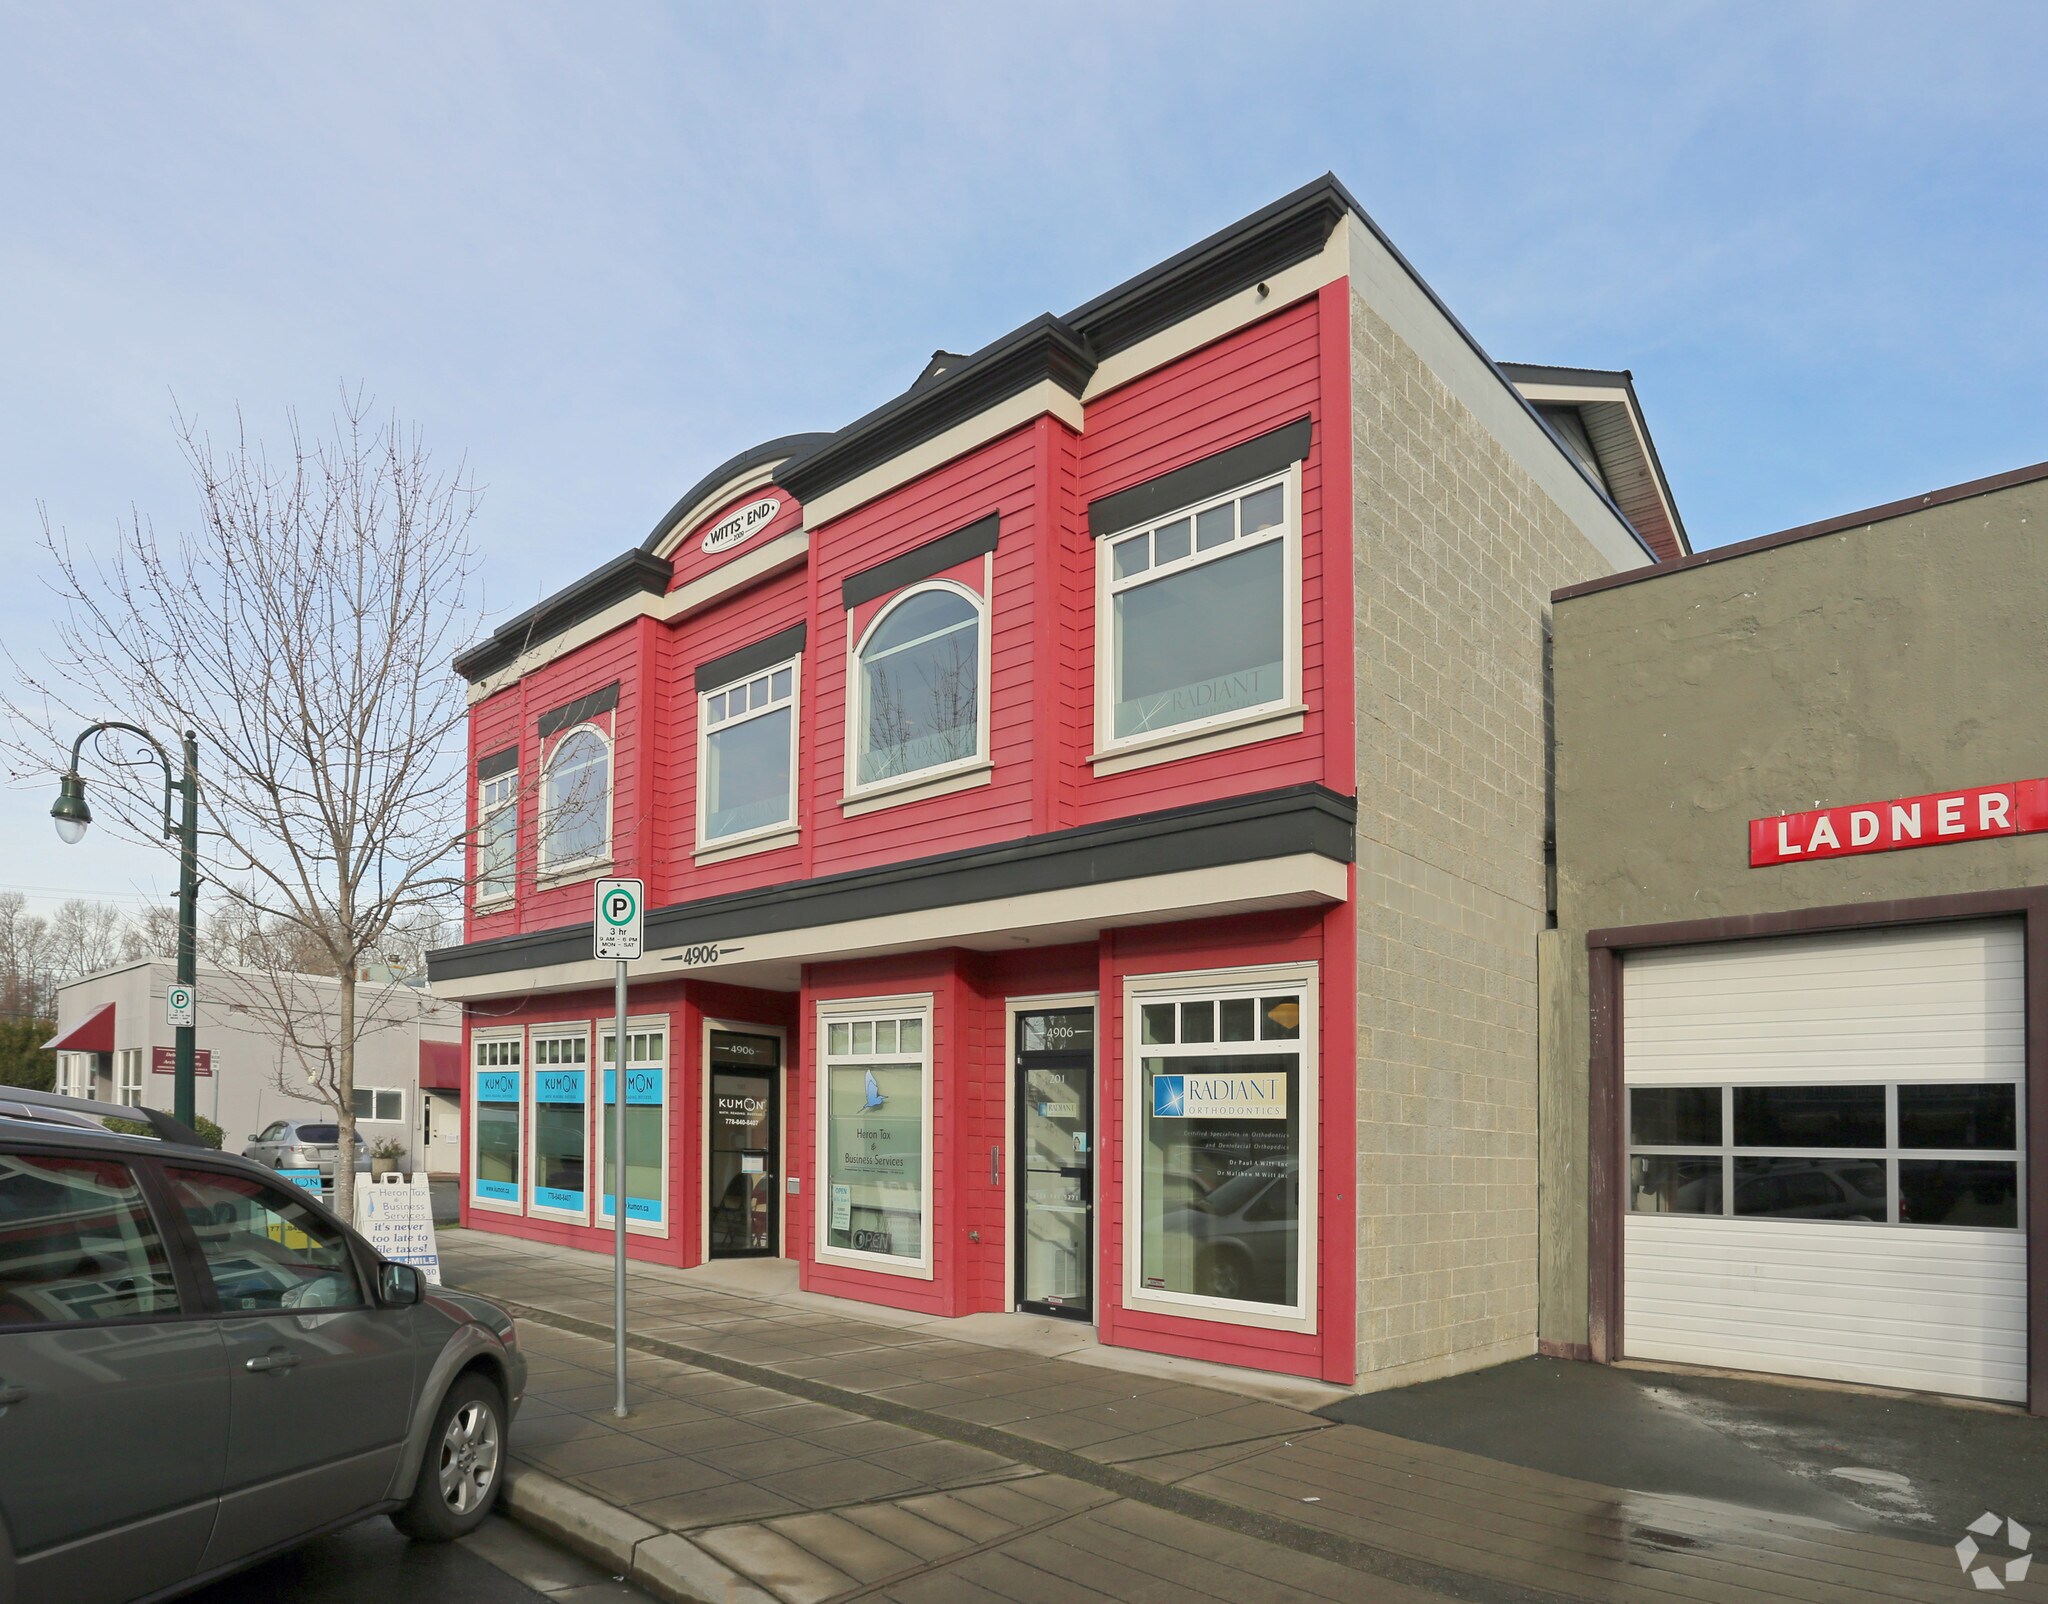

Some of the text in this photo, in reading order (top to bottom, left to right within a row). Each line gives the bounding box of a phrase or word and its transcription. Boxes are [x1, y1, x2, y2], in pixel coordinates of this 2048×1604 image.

[710, 503, 770, 544] WITTS' END
[1172, 669, 1263, 712] RADIANT
[1777, 792, 2011, 856] LADNER
[612, 898, 628, 918] P
[610, 927, 627, 936] 3 hr
[683, 944, 718, 966] 4906
[176, 994, 185, 1005] P
[1046, 1027, 1074, 1038] 4906
[730, 1045, 755, 1056] 4906
[485, 1075, 513, 1093] KUMON
[545, 1075, 578, 1093] KUMON
[628, 1073, 653, 1093] MON
[1049, 1074, 1065, 1084] 201
[1189, 1079, 1280, 1100] RADIANT
[718, 1097, 764, 1112] KUMON
[1188, 1106, 1280, 1115] ORTHODONTICS
[856, 1128, 891, 1140] Heron Tax
[1210, 1130, 1240, 1138] Specialists
[1251, 1131, 1290, 1139] Orthodontics
[870, 1142, 877, 1151] &
[1253, 1143, 1289, 1151] Orthopedics
[844, 1152, 904, 1167] Business Services
[379, 1188, 426, 1197] Heron Tax
[383, 1202, 425, 1211] Business
[384, 1211, 425, 1220] Services
[374, 1222, 390, 1231] it's
[372, 1233, 428, 1243] too late to
[854, 1230, 889, 1250] OPEN
[396, 1243, 428, 1253] taxes!
[404, 1256, 436, 1265] SMILE
